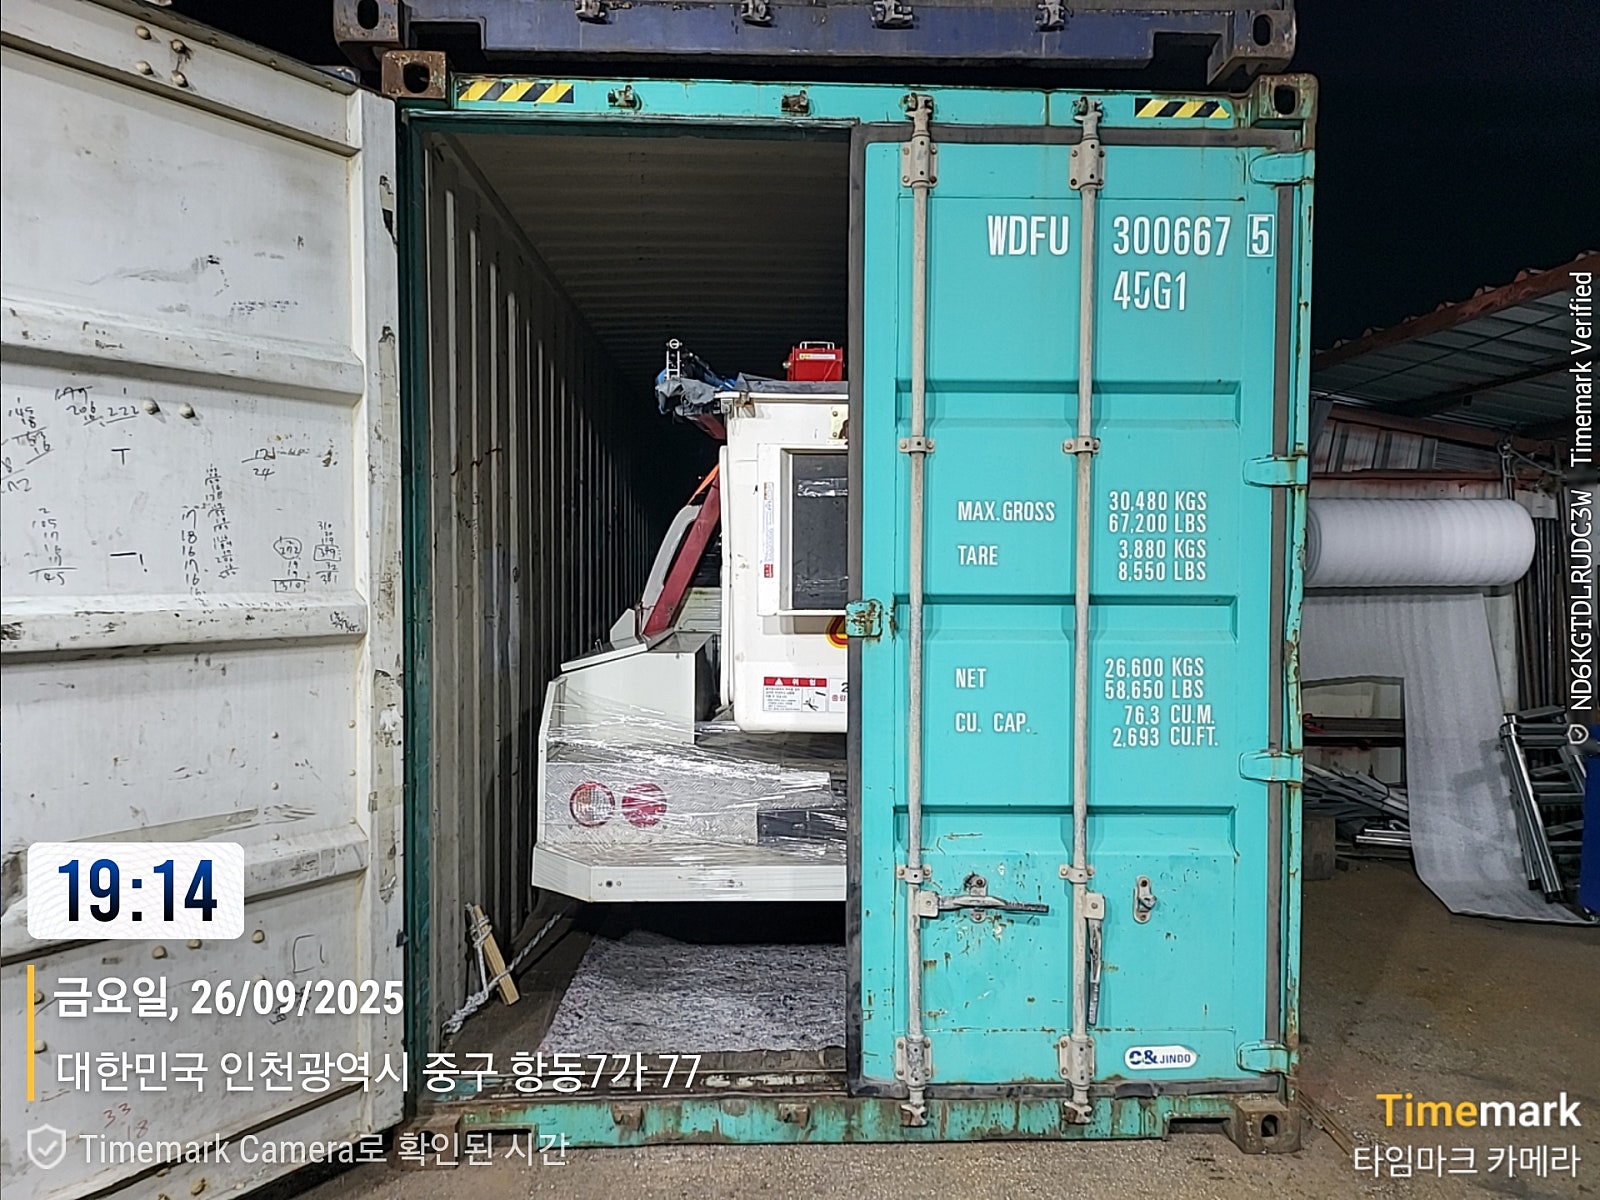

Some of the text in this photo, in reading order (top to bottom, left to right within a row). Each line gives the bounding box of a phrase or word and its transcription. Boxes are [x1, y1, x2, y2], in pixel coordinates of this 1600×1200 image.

[987, 215, 1270, 256] WDFU 300667 5
[1113, 271, 1186, 311] 45G1
[958, 501, 1056, 521] MAX. GROSS
[1109, 491, 1207, 512] 30,480 KGS
[1109, 513, 1207, 534] 67,200 LBS
[958, 545, 998, 566] TARE
[1118, 538, 1207, 560] 3,880 KGS
[1118, 561, 1207, 582] 8,550 LBS
[955, 668, 986, 689] NET
[1104, 657, 1205, 679] 26,600 KGS
[1104, 679, 1205, 700] 58,650 LBS
[955, 712, 1031, 732] CU. CAP.
[1124, 704, 1215, 725] 76.3 CU.M.
[1112, 726, 1219, 748] 2,693 CU.FT.
